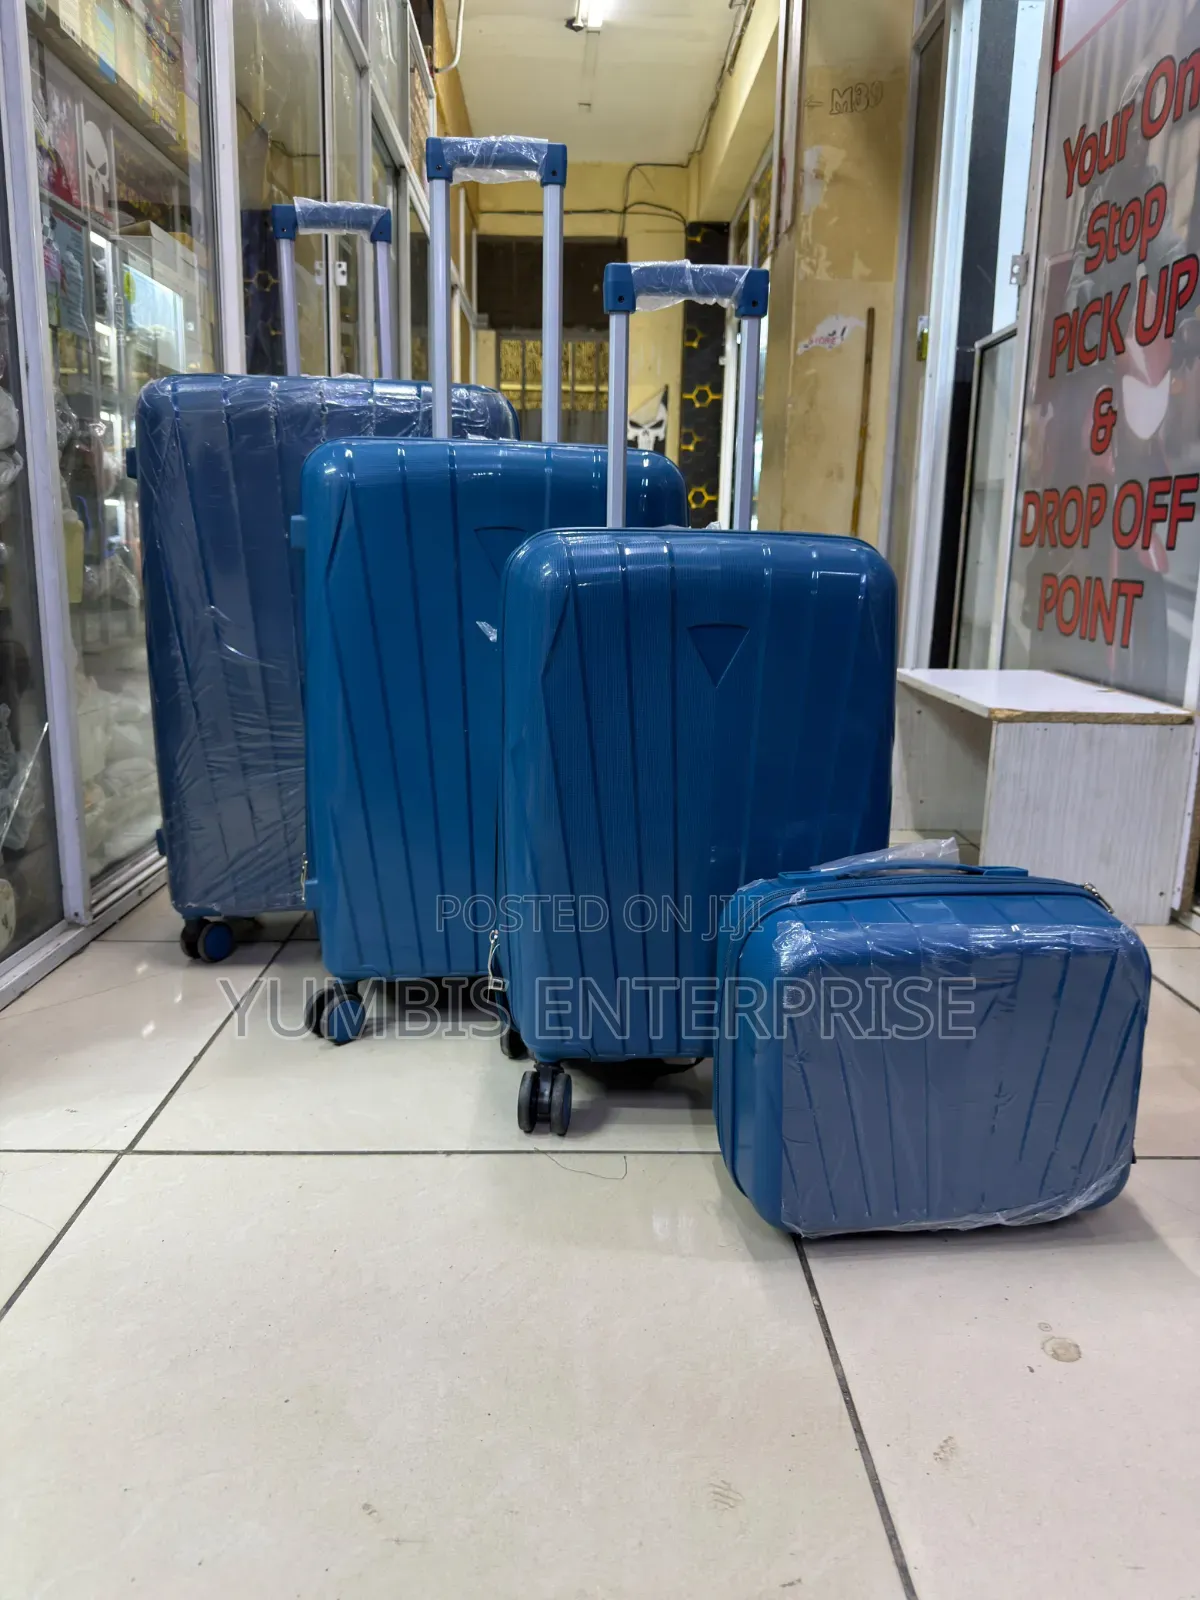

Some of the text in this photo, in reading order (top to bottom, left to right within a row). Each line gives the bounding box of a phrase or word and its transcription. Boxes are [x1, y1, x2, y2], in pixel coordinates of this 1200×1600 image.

[1063, 99, 1135, 199] Your
[1084, 182, 1167, 275] Stop
[1048, 253, 1199, 379] PICK UP
[1090, 386, 1118, 455] &
[1019, 473, 1199, 551] DROP OFF
[1037, 573, 1145, 650] POINT
